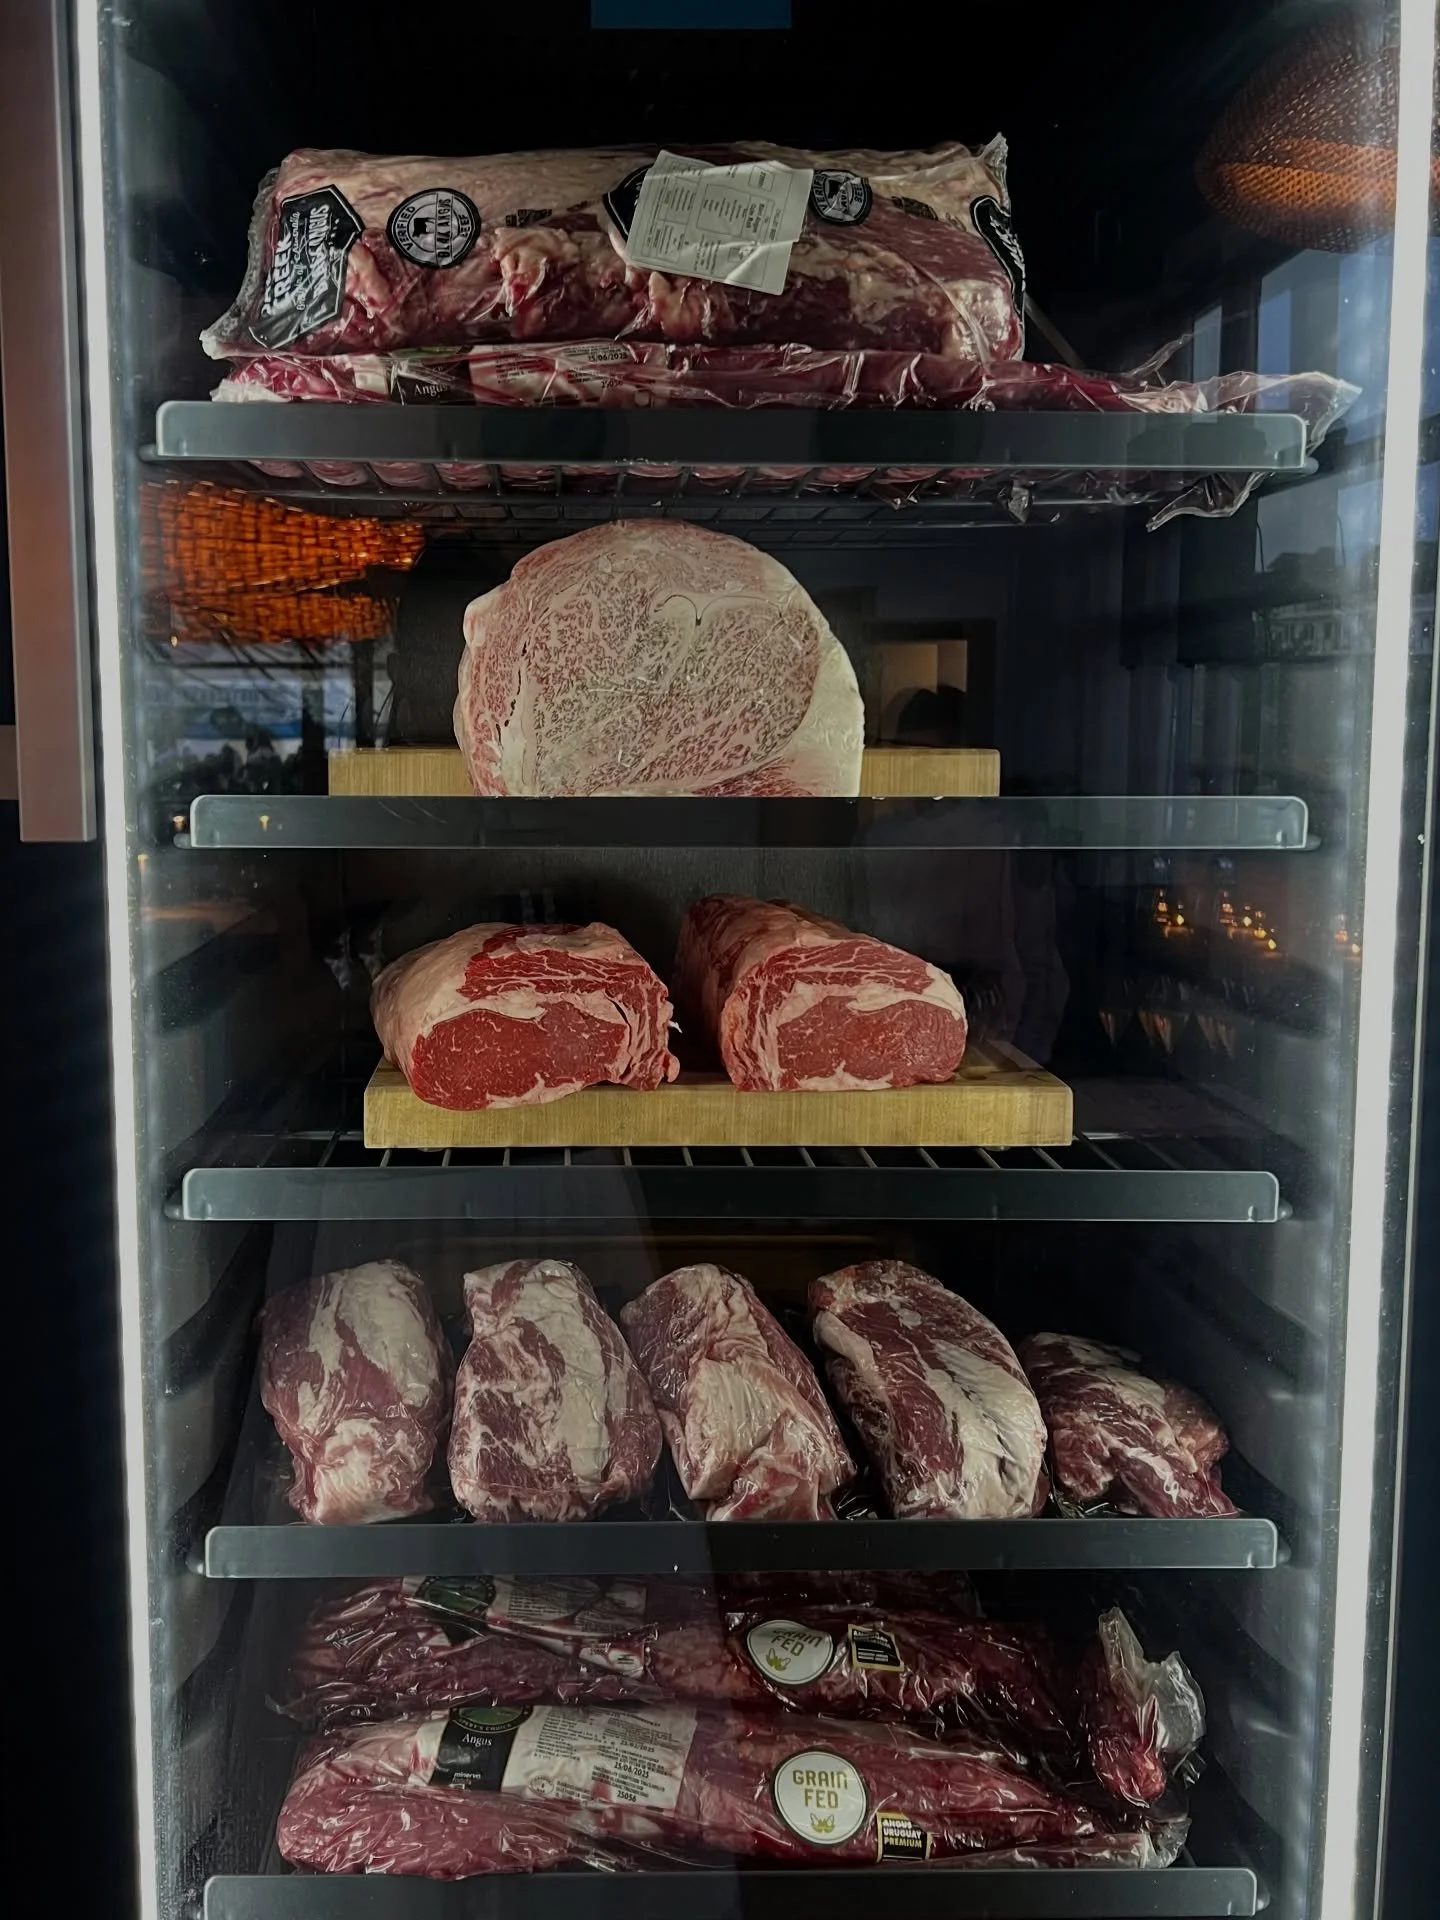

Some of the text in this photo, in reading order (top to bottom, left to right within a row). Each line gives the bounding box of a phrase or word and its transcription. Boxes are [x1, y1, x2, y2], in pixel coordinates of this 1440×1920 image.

[397, 206, 416, 251] VERFIED
[273, 234, 293, 311] CREEK
[771, 1635, 805, 1656] FED
[462, 1733, 492, 1747] Angus
[793, 1769, 848, 1790] GRAIN
[804, 1788, 839, 1809] FED
[883, 1817, 912, 1829] ANGUS
[883, 1828, 922, 1839] URUGUAY
[884, 1837, 922, 1848] PREMIUM
